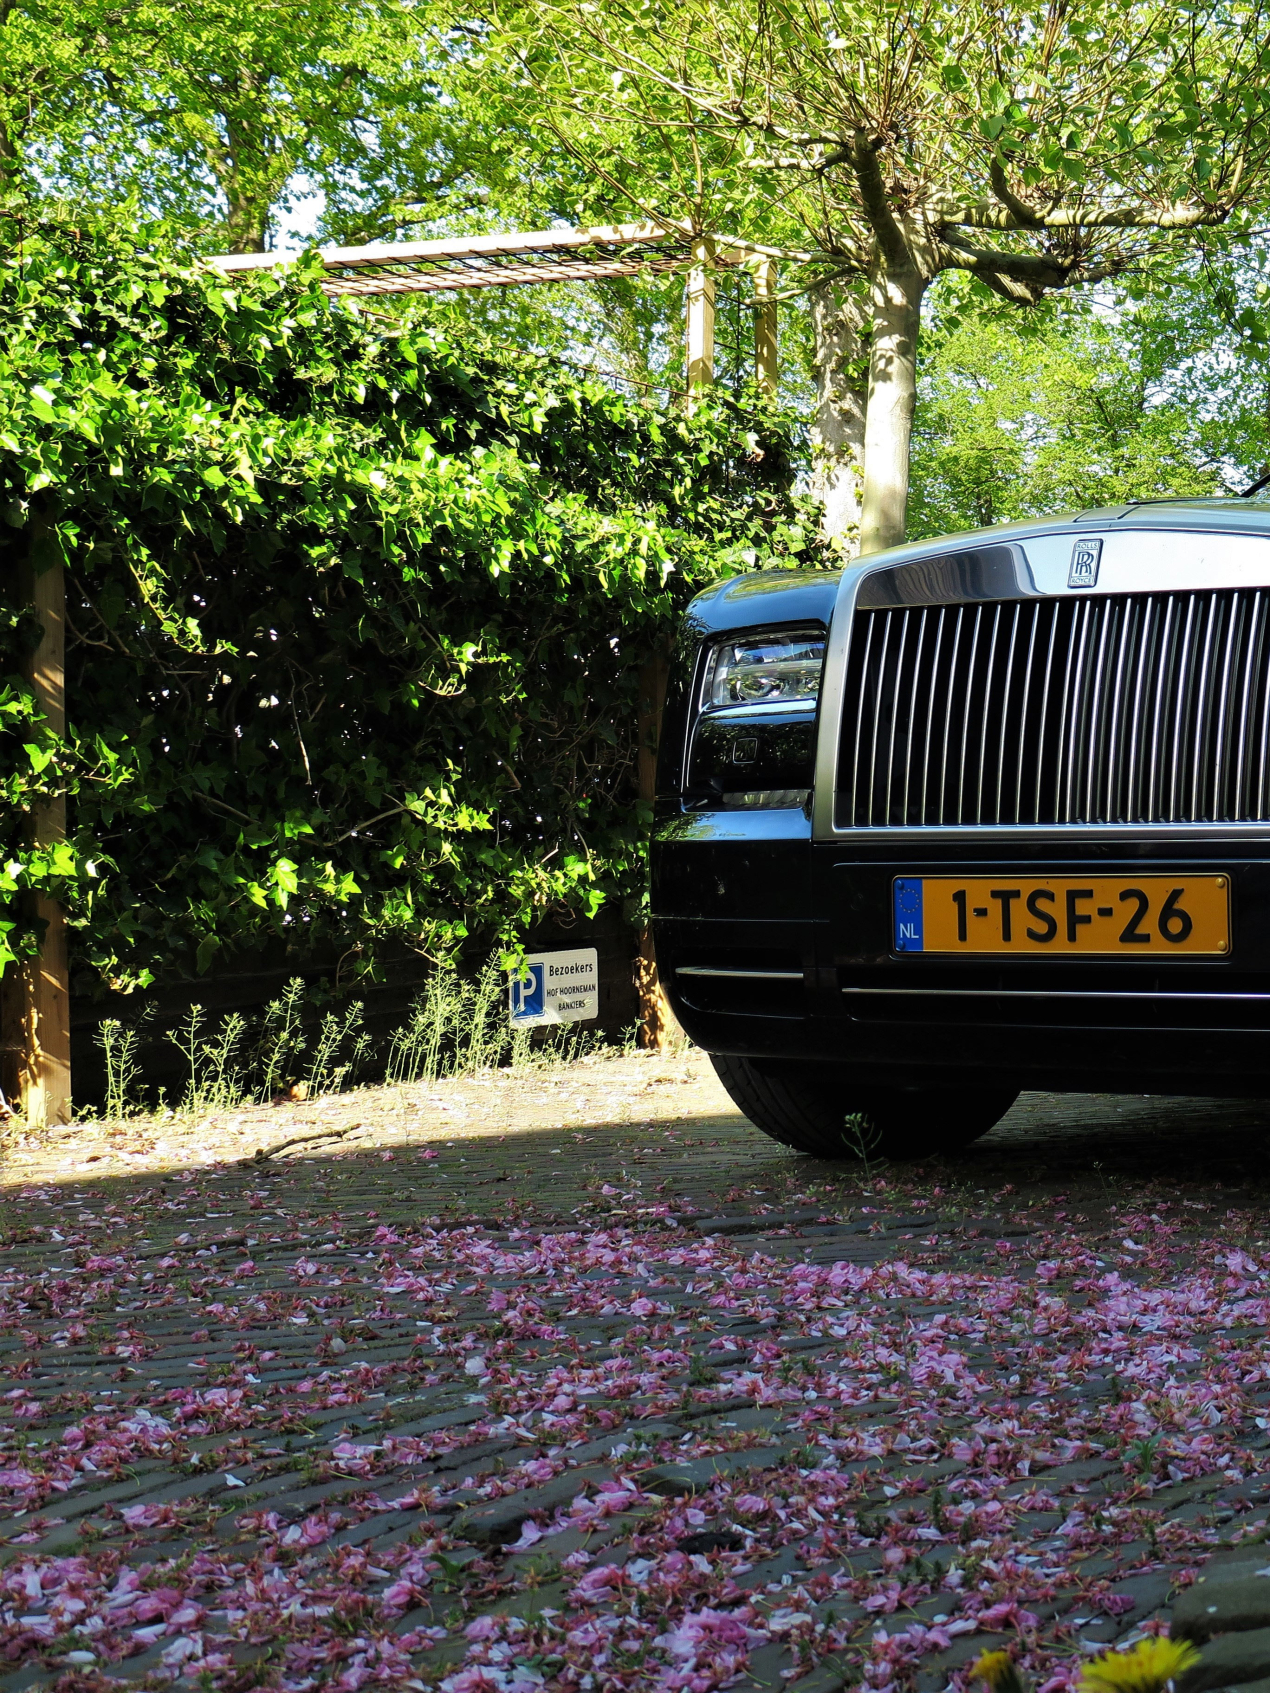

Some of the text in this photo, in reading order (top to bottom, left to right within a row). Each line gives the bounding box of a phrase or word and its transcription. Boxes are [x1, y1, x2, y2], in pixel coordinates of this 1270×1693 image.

[1074, 551, 1094, 576] RR
[952, 888, 1193, 943] 1-TSF-26
[899, 922, 920, 939] NL
[549, 962, 593, 977] Bezoekers
[520, 971, 537, 1012] P
[546, 983, 596, 998] HOF HOORNEMAN
[558, 1000, 586, 1011] BANKIERS
